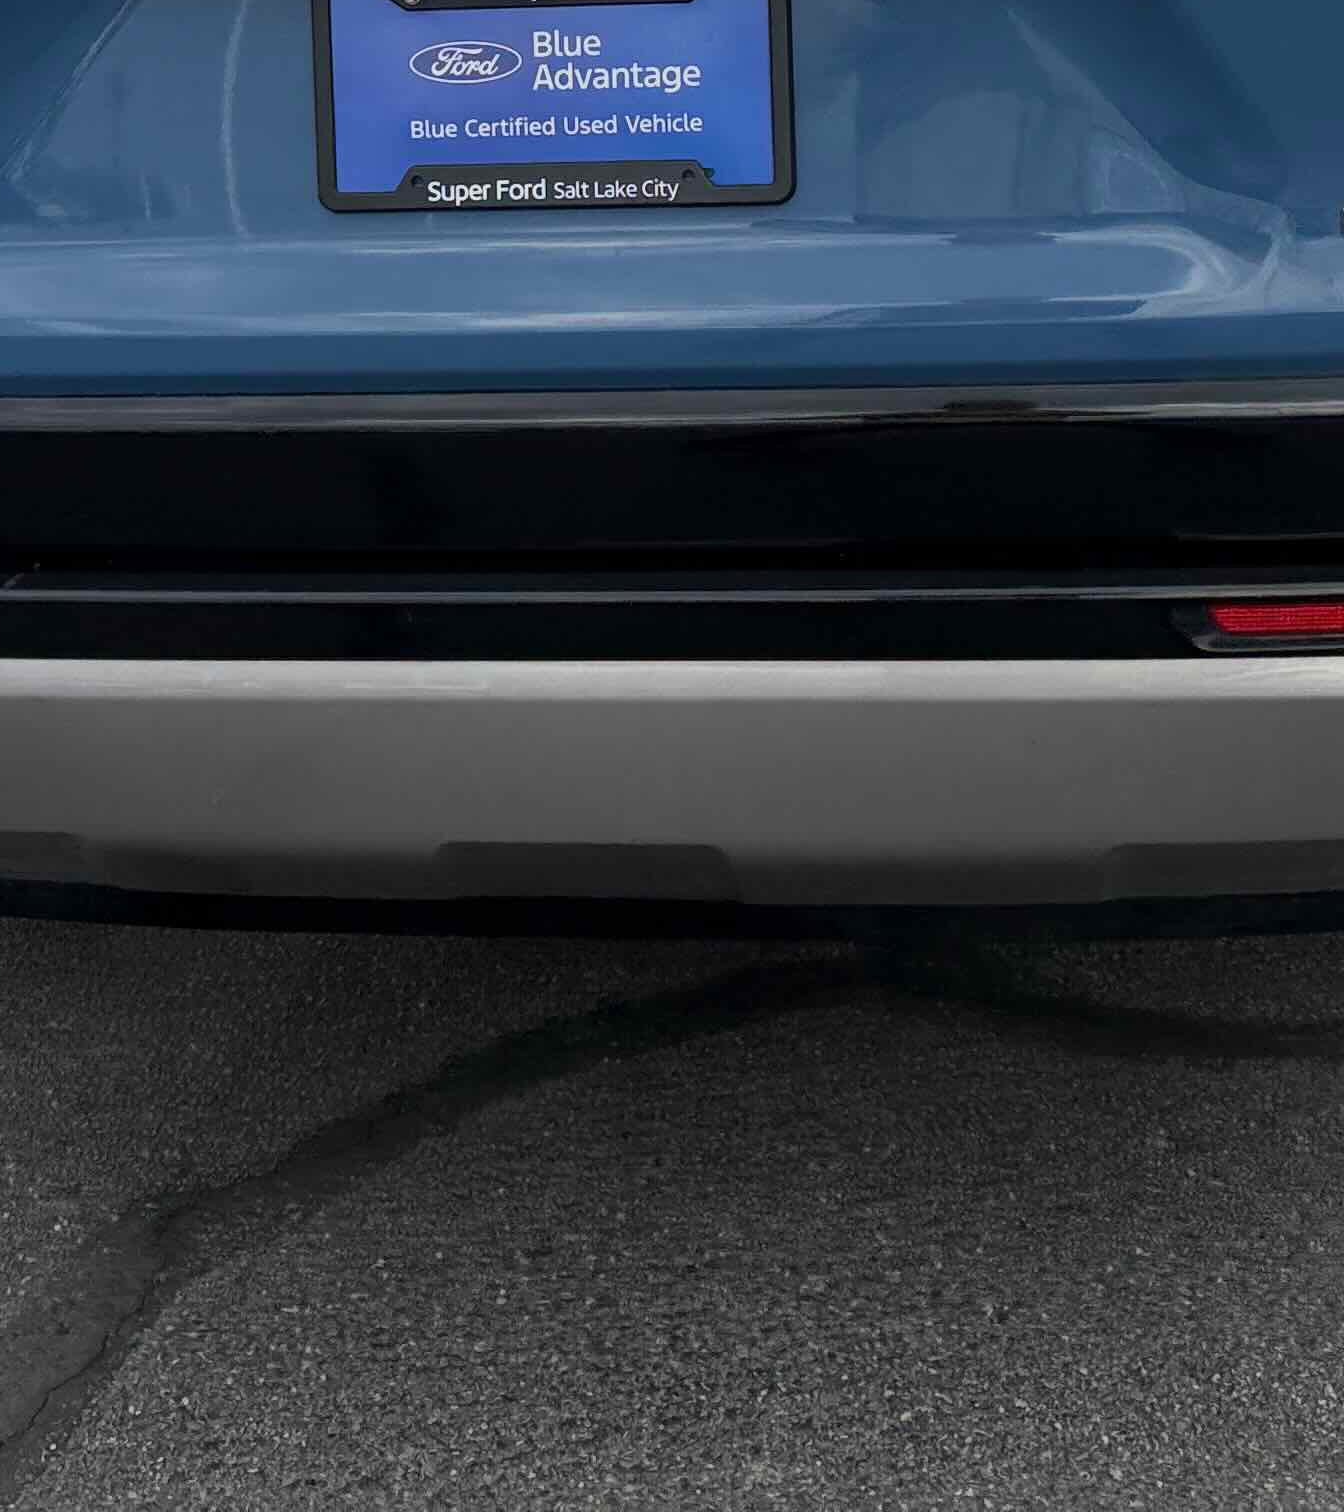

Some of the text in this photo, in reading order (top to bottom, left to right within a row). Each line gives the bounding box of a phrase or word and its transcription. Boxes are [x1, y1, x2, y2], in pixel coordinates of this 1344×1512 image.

[533, 29, 601, 58] Blue
[431, 47, 500, 76] Ford
[532, 59, 701, 93] Advantage
[410, 113, 703, 139] Blue Certified Used Vehicle
[427, 178, 680, 206] Super Ford Salt Lake City
